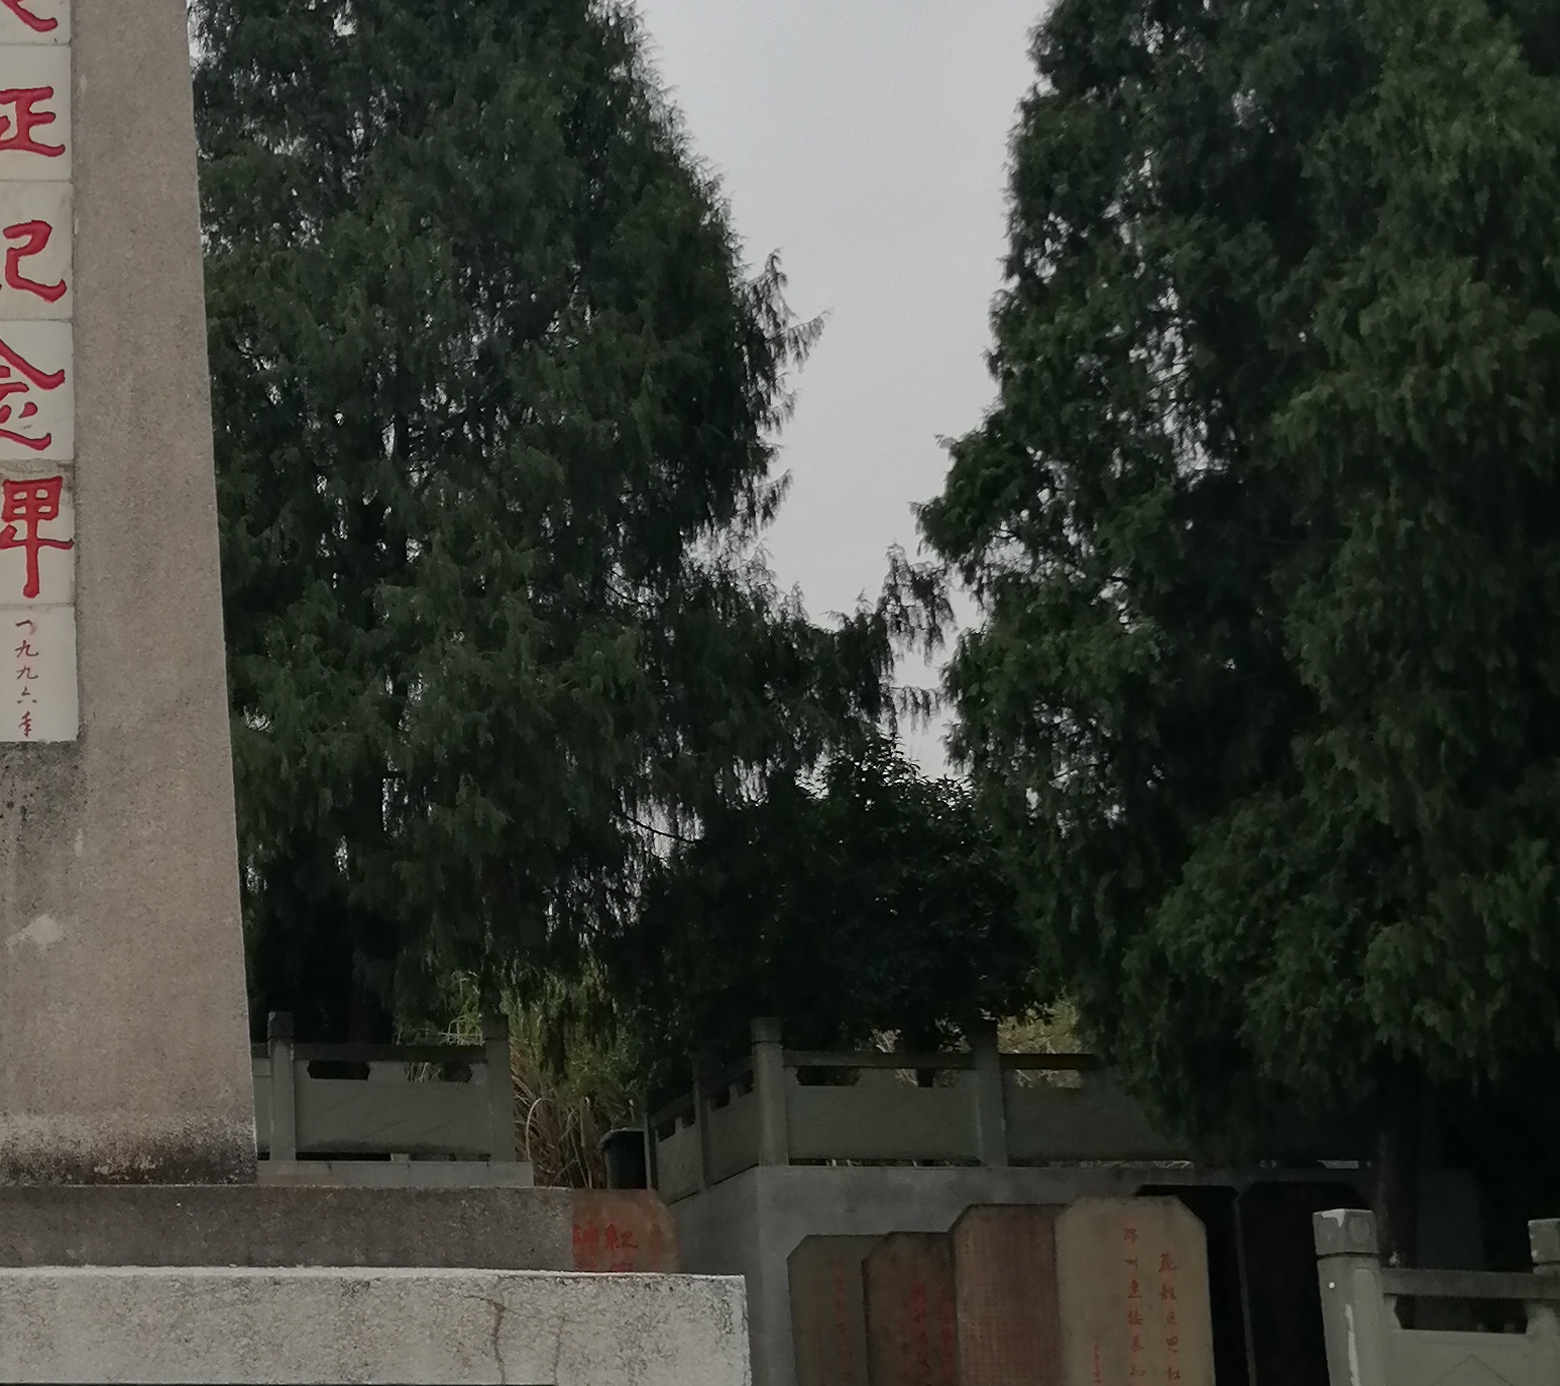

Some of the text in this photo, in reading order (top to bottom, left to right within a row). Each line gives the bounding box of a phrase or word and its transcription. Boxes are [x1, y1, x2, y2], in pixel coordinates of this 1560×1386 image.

[15, 618, 40, 738] 一九九六年
